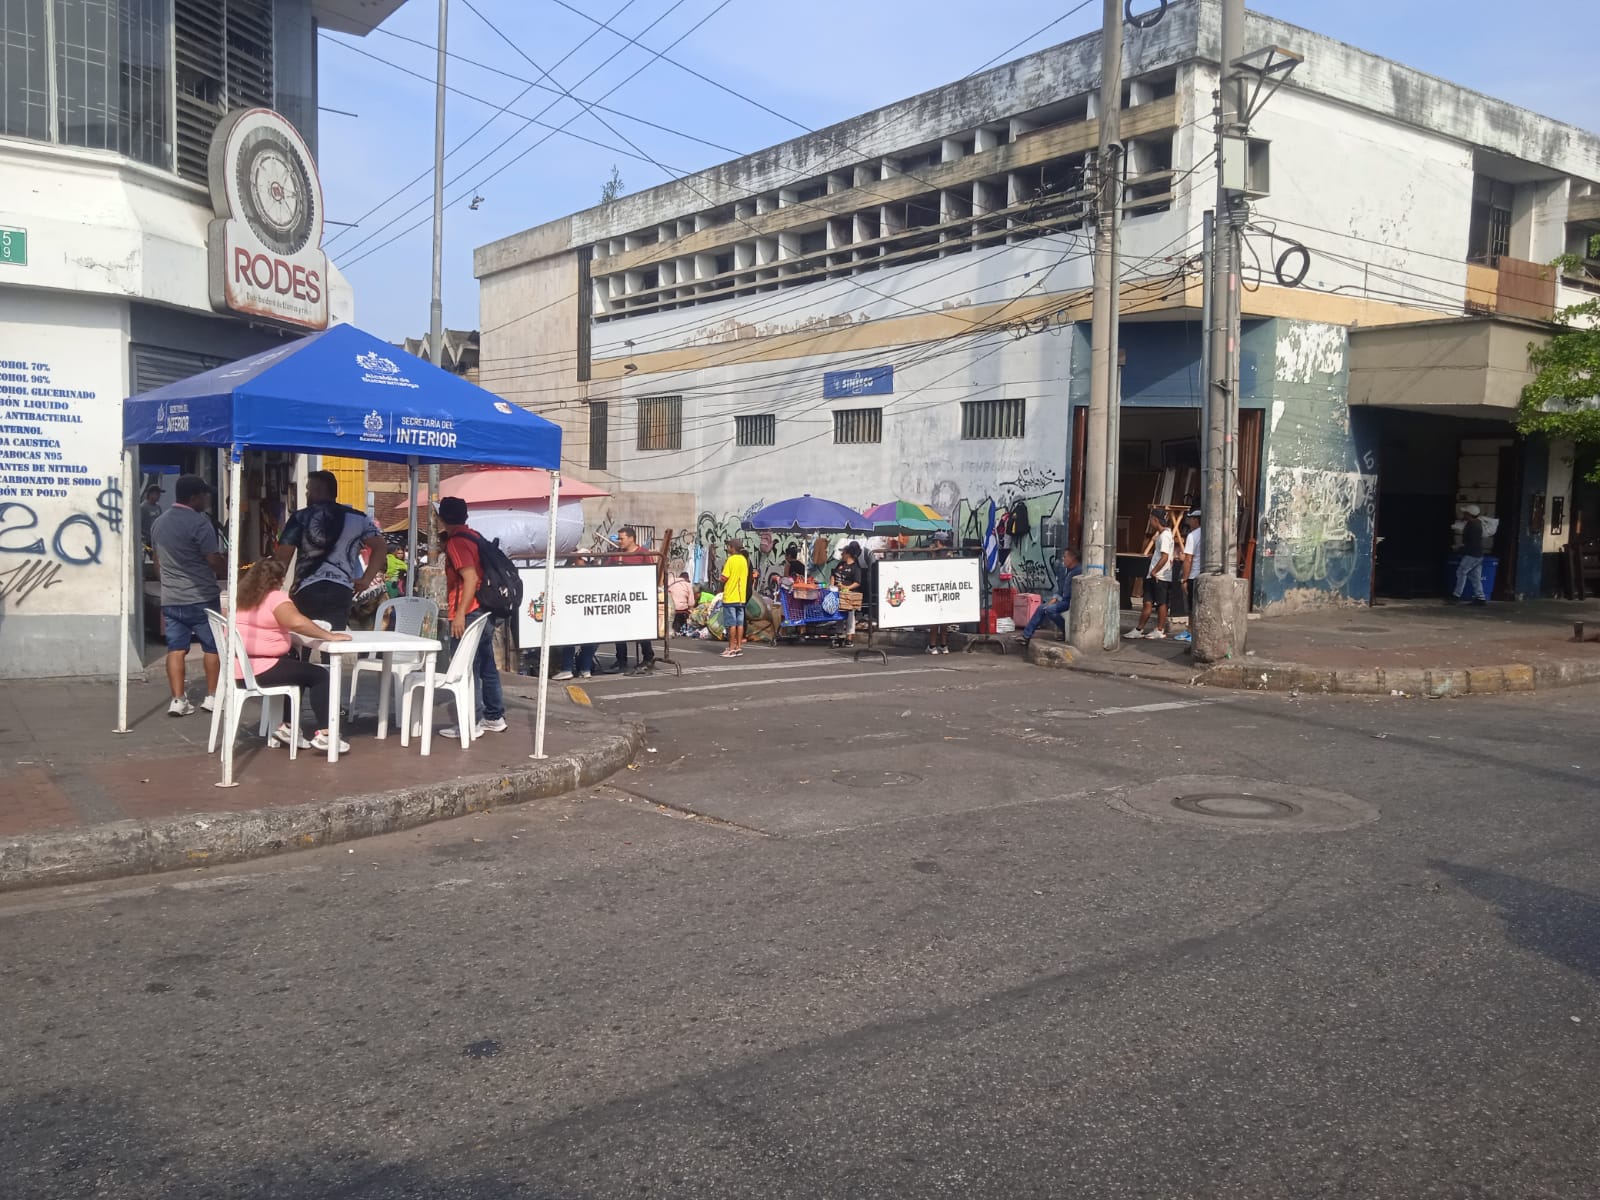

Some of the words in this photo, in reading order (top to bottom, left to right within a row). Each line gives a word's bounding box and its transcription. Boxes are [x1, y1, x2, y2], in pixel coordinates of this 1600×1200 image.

[235, 247, 321, 303] RODES
[0, 360, 28, 370] OHOL
[31, 362, 50, 372] 70%
[0, 372, 28, 383] OHOL
[31, 374, 50, 384] 96%
[0, 385, 28, 395] OHOL
[31, 387, 96, 400] GLICERINADO
[24, 399, 69, 410] LIQUIDO
[5, 411, 83, 423] ANTIBACTERIAL
[13, 438, 61, 448] CAUSTICA
[396, 427, 457, 449] INTERIOR
[44, 452, 63, 461] N95
[32, 464, 46, 473] DE
[48, 465, 88, 474] NITRILO
[0, 475, 55, 485] ARBONATO
[57, 477, 71, 486] DE
[72, 478, 102, 487] SODIO
[20, 488, 34, 497] EN
[36, 489, 68, 498] POLVO
[911, 580, 958, 593] SECRETARÍA
[958, 581, 973, 590] DEL
[565, 590, 627, 604] SECRETARÍA
[629, 591, 648, 601] DEL
[924, 592, 961, 603] INTRIOR
[583, 604, 631, 616] INTERIOR
